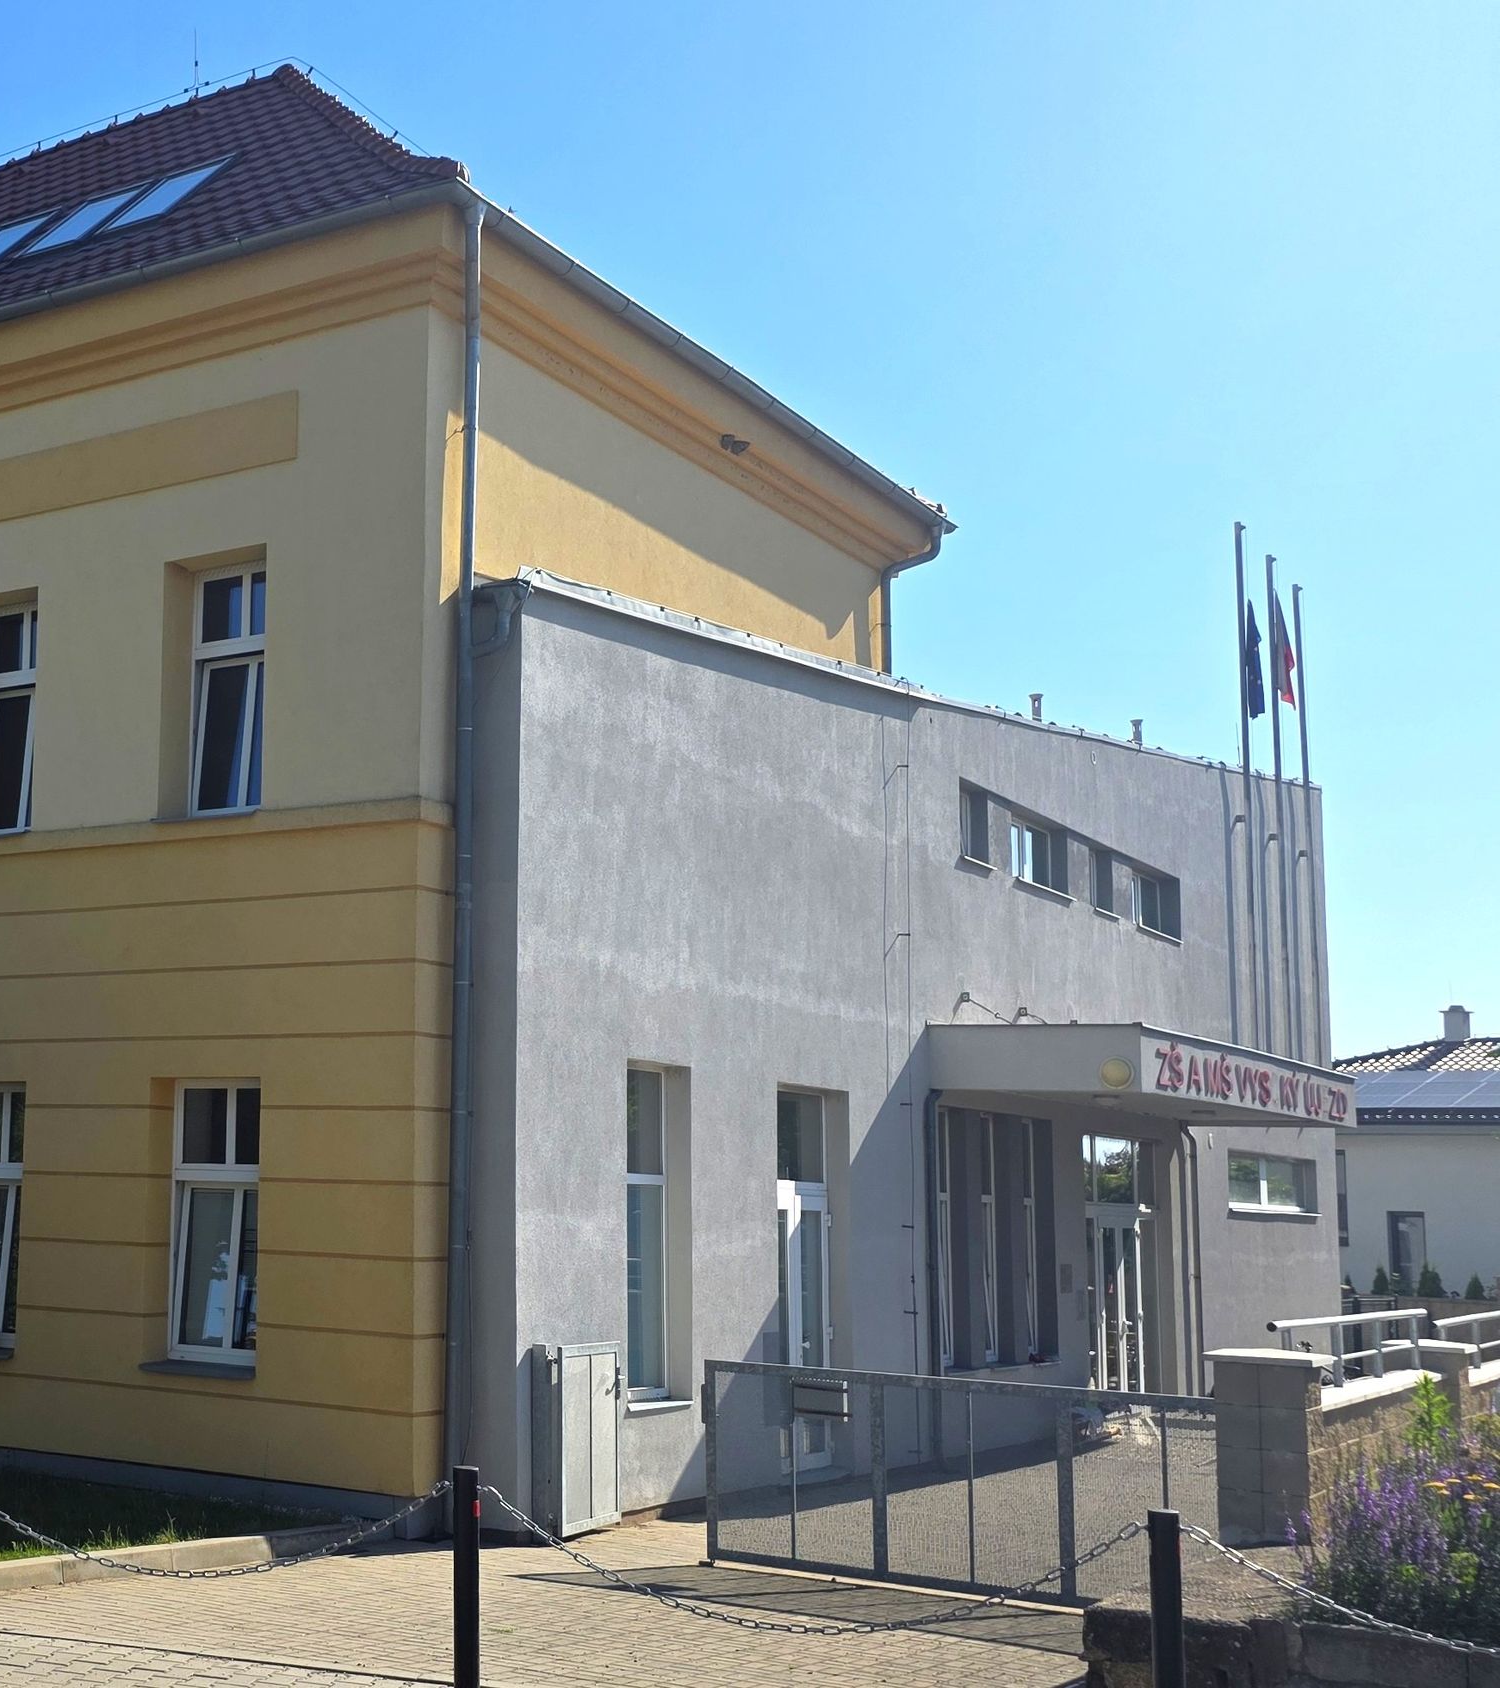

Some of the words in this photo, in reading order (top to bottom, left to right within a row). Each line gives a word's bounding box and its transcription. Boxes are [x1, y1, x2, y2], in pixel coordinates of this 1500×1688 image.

[1155, 1041, 1185, 1093] ZŠ
[1187, 1055, 1203, 1096] A
[1203, 1053, 1234, 1101] MŠ
